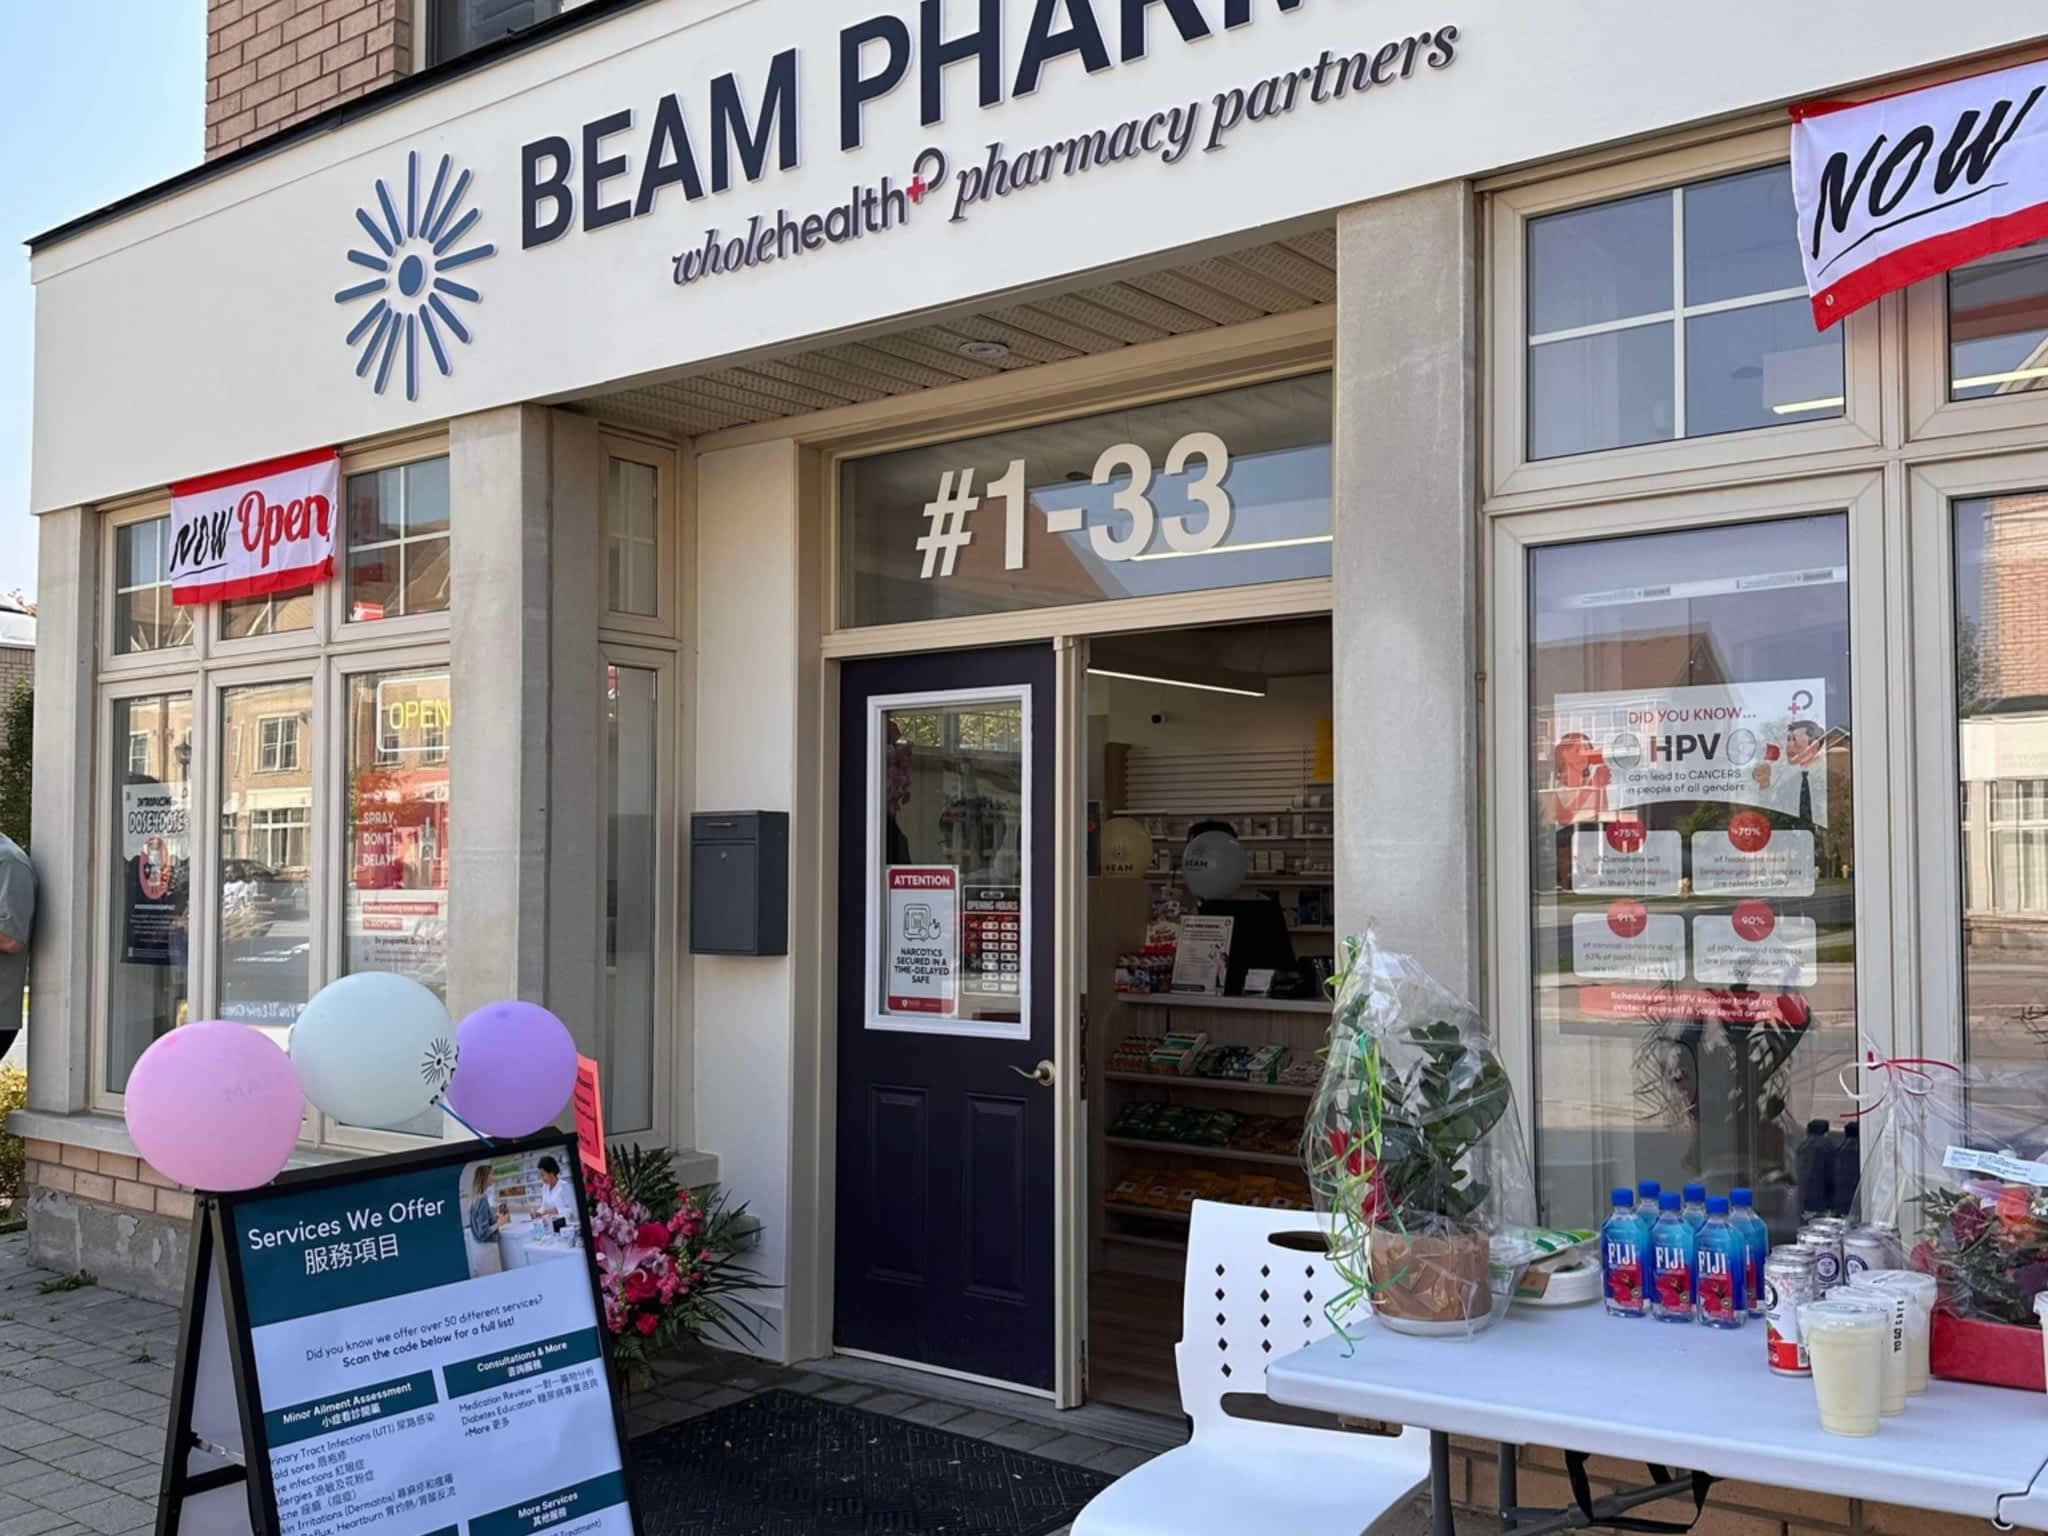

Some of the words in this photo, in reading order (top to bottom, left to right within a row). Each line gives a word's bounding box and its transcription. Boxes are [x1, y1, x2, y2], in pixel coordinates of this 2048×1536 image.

[522, 48, 799, 249] BEAM
[840, 0, 1304, 151] PHA
[672, 175, 909, 286] wholehealth
[948, 102, 1200, 222] pharmacy
[1203, 25, 1460, 152] partners
[1811, 85, 2047, 260] NOW
[916, 432, 1233, 578] #1-33
[169, 506, 234, 573] NOW
[237, 490, 331, 568] Open
[390, 699, 451, 729] OPEN
[1628, 711, 1654, 724] DID
[1658, 709, 1689, 722] YOU
[1650, 733, 1721, 762] HPV
[1628, 773, 1648, 781] can
[1650, 771, 1672, 781] lead
[1675, 771, 1686, 780] to
[1688, 769, 1742, 780] CANCERS
[1637, 783, 1671, 795] people
[1674, 783, 1686, 793] of
[1688, 783, 1699, 793] all
[894, 874, 950, 886] ATTENTION
[896, 956, 930, 966] SECURED
[932, 957, 940, 966] IN
[941, 957, 947, 966] A
[900, 947, 943, 957] NARCOTICS
[894, 965, 950, 976] TIME-DELAYED
[911, 974, 931, 984] SAFE
[248, 1219, 342, 1250] Services
[346, 1208, 383, 1232] We
[388, 1197, 445, 1224] Offer
[304, 1233, 399, 1275] 服務項目
[1607, 1242, 1637, 1265] FIJI
[1655, 1246, 1685, 1269] FIJI
[1698, 1250, 1727, 1274] FIJI
[306, 1347, 324, 1361] Did
[325, 1345, 344, 1360] you
[345, 1336, 374, 1351] know
[376, 1331, 392, 1344] we
[393, 1325, 418, 1342] offer
[420, 1320, 443, 1333] over
[444, 1314, 457, 1327] 50
[459, 1306, 501, 1325] different
[502, 1294, 544, 1314] services?
[342, 1353, 371, 1368] Scan
[373, 1346, 390, 1361] the
[392, 1340, 418, 1355] code
[420, 1334, 452, 1349] below
[455, 1327, 469, 1341] for
[471, 1327, 480, 1336] a
[480, 1318, 496, 1333] full
[497, 1316, 516, 1330] list!
[477, 1349, 536, 1373] Consultations
[537, 1346, 545, 1356] &
[545, 1341, 568, 1354] More
[282, 1407, 312, 1425] Minor
[313, 1397, 351, 1416] Ailment
[352, 1382, 412, 1406] Assessment
[459, 1393, 501, 1414] Medication
[502, 1387, 532, 1402] Review
[461, 1410, 497, 1426] Diabetes
[497, 1399, 536, 1416] Education
[270, 1452, 299, 1466] rinary
[300, 1443, 326, 1459] Tract
[327, 1432, 372, 1452] Infections
[373, 1423, 396, 1440] (UTI)
[273, 1468, 289, 1481] old
[291, 1462, 316, 1476] sores
[275, 1483, 288, 1497] ye
[289, 1470, 333, 1489] infections
[279, 1491, 313, 1507] llergies
[517, 1503, 541, 1519] More
[541, 1491, 578, 1511] Services
[281, 1509, 299, 1521] cne
[281, 1524, 296, 1536] kin
[298, 1510, 343, 1531] Irritations
[336, 1511, 385, 1533] Heartburn
